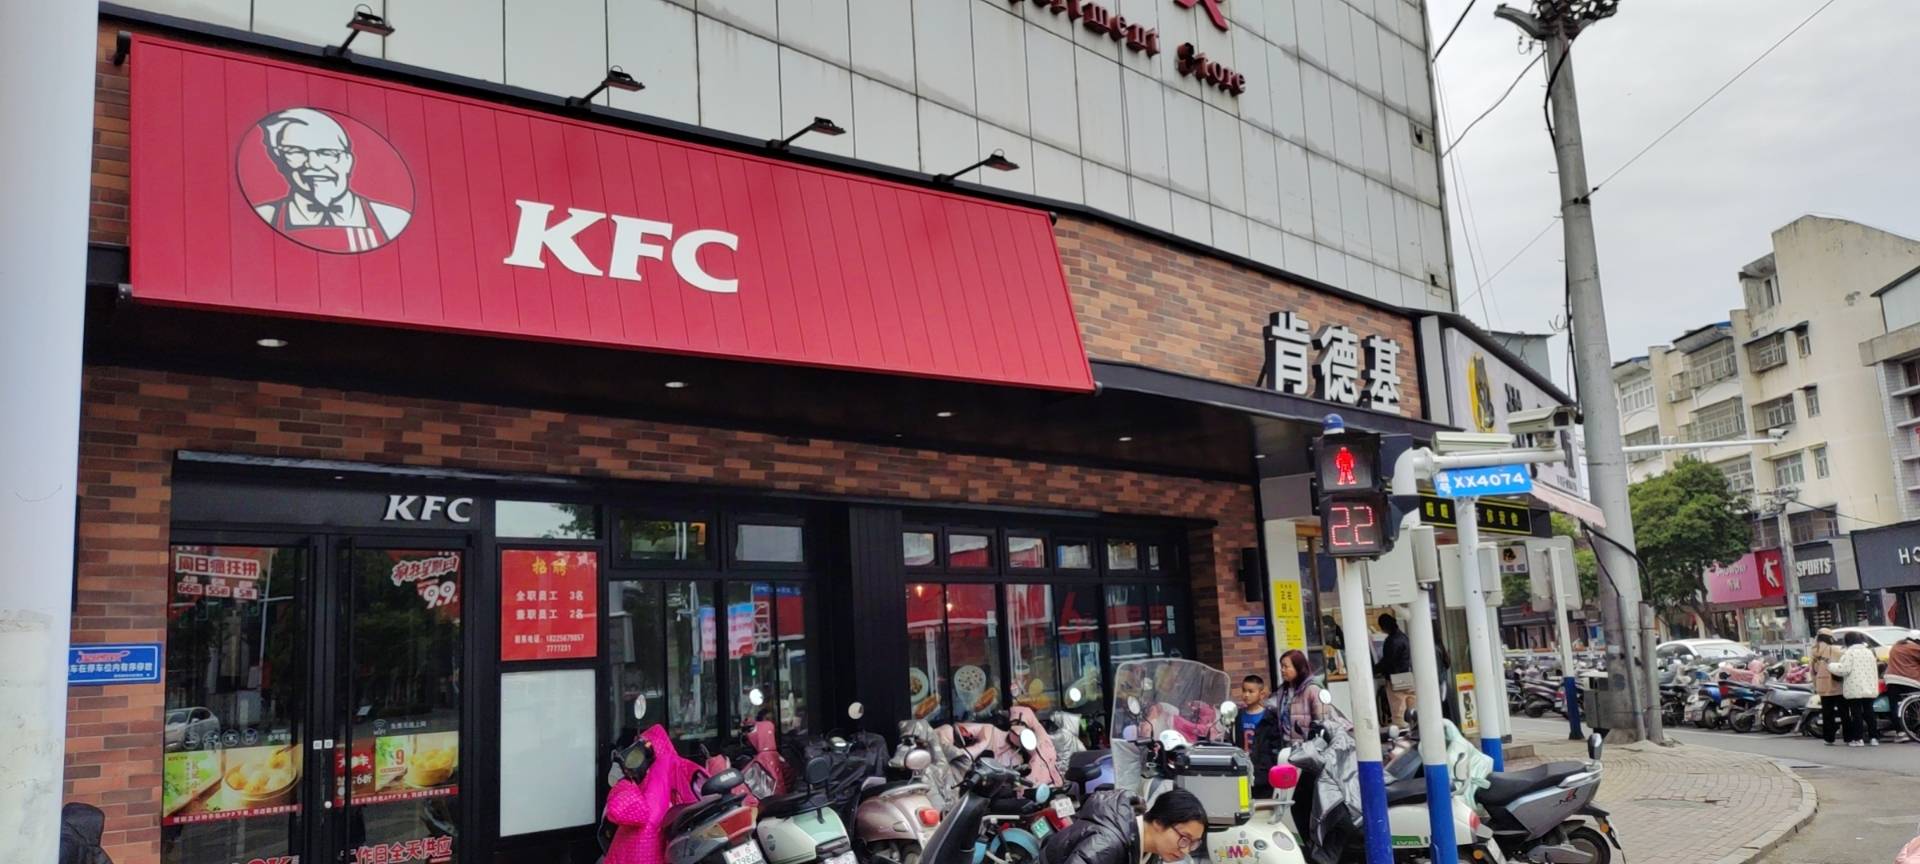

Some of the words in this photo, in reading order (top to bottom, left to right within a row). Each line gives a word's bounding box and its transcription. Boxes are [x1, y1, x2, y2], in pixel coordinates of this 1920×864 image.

[1177, 41, 1246, 97] Store
[503, 199, 739, 293] KFC
[1266, 311, 1401, 415] 肯德基
[1453, 472, 1525, 489] XX4074
[383, 494, 473, 523] KFC
[1330, 505, 1375, 546] 22
[531, 556, 568, 577] 招聘
[1796, 557, 1832, 578] SPORTS
[516, 590, 558, 602] 全职员工
[568, 590, 584, 601] 3名
[568, 609, 584, 620] 2名
[340, 836, 453, 864] 作日全天供应
